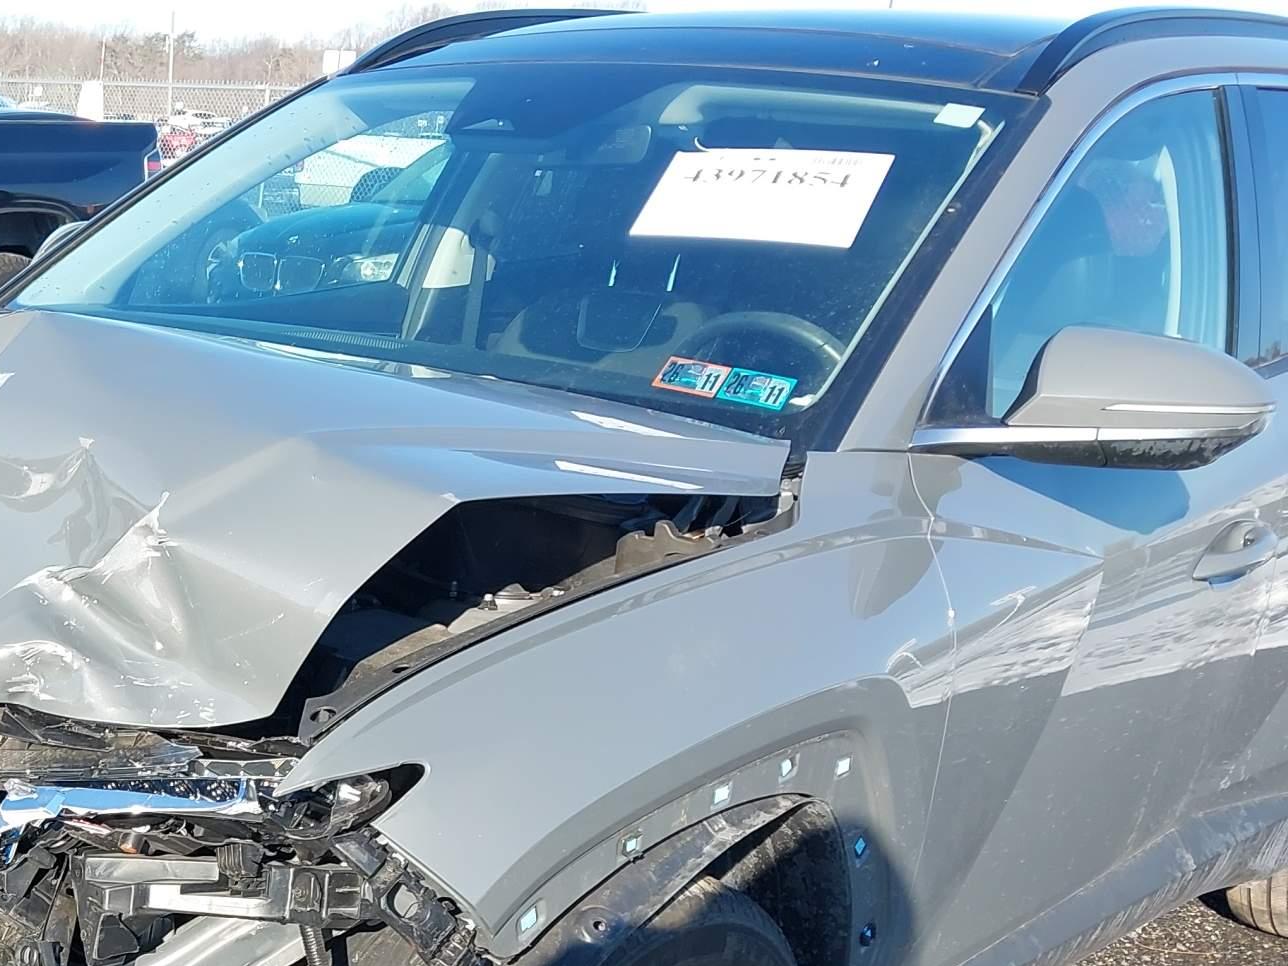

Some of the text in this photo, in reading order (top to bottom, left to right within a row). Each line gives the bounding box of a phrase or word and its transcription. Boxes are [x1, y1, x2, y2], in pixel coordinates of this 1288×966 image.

[660, 361, 721, 392] 26 11
[726, 373, 786, 405] 26 11
